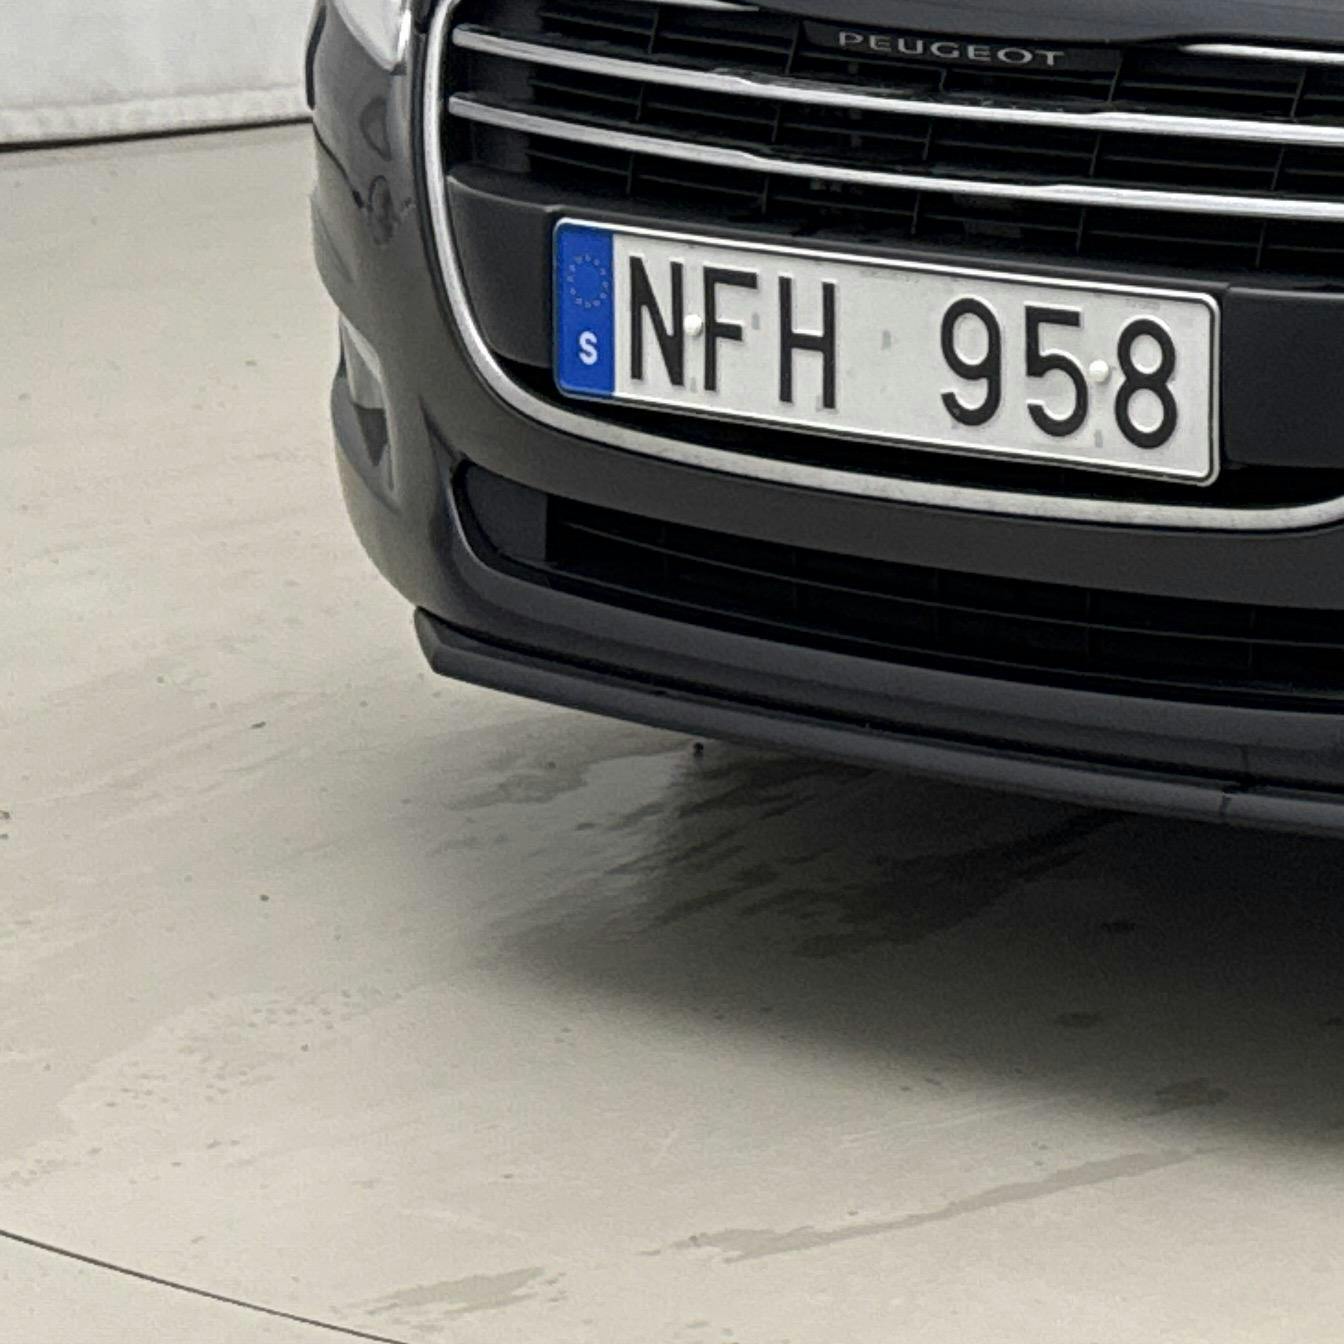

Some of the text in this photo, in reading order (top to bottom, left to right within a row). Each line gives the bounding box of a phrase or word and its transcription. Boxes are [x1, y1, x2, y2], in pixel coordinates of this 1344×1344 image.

[838, 31, 1064, 66] PEUGEOT
[578, 330, 598, 366] S
[628, 256, 1179, 449] NFH 958
